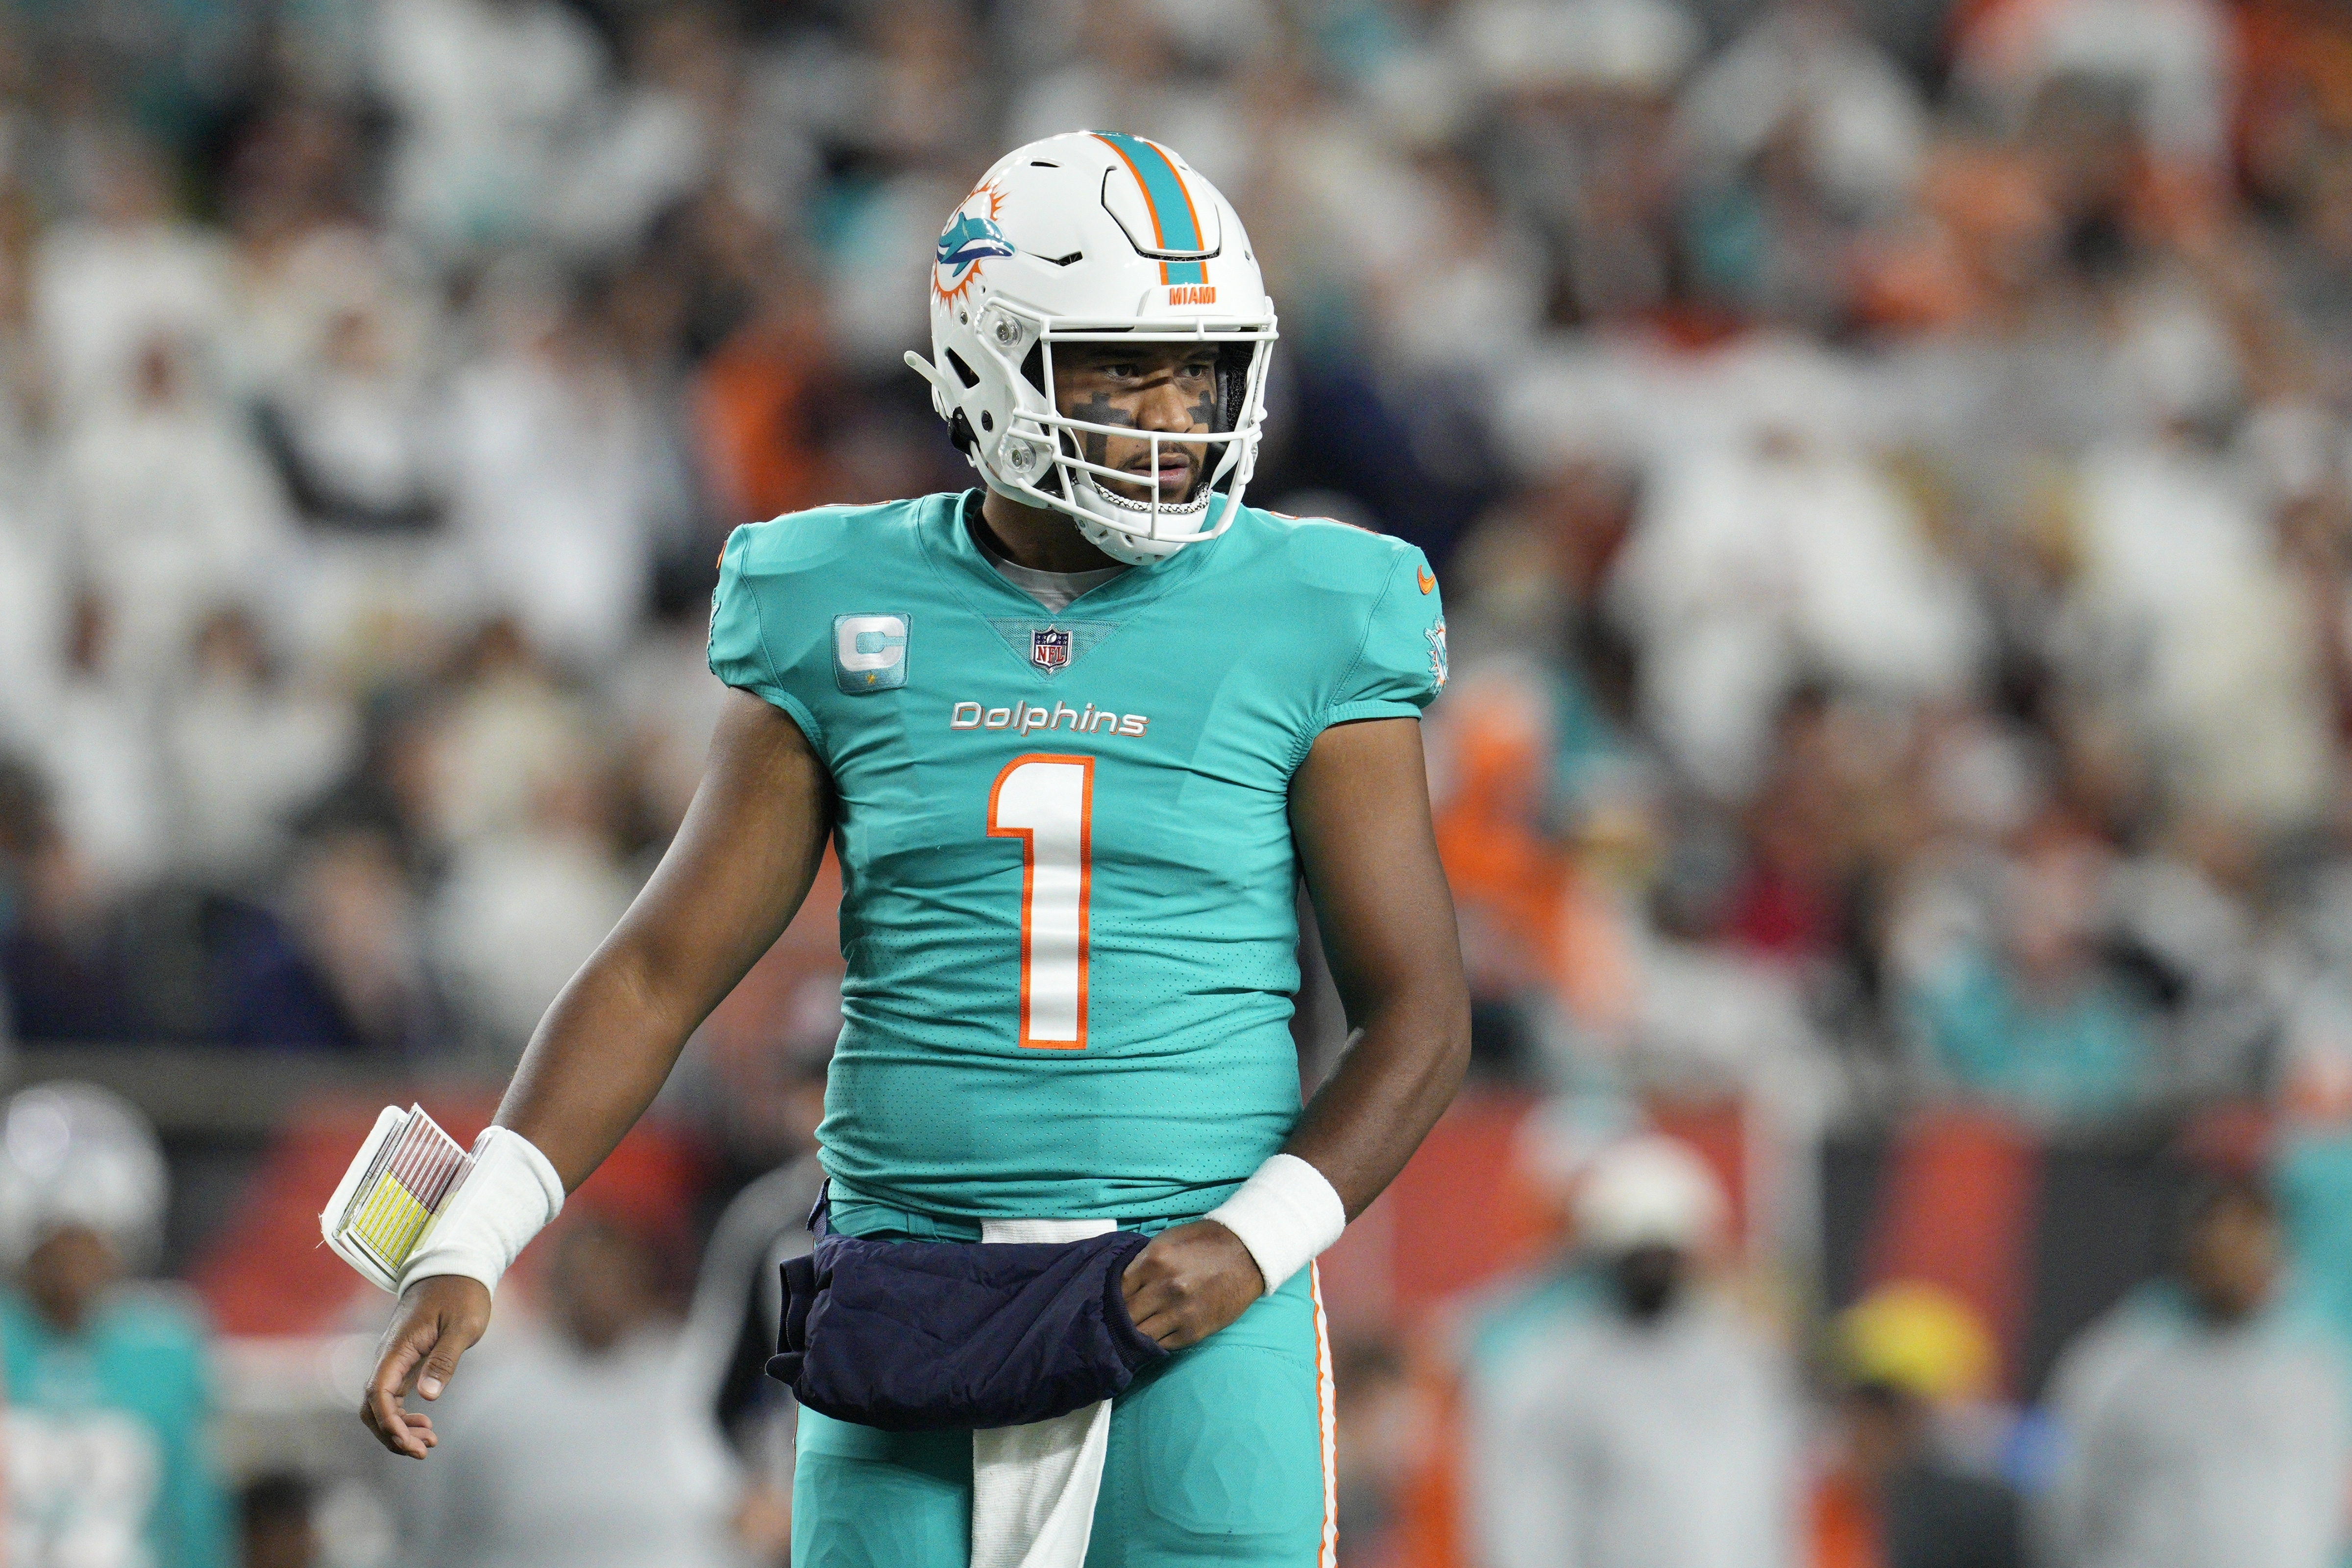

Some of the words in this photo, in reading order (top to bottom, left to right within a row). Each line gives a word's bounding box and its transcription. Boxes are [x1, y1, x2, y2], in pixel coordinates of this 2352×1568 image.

[1170, 287, 1216, 305] MIAMI
[838, 616, 906, 670] C
[1037, 646, 1064, 663] NFL
[951, 700, 1149, 736] Dolphins
[986, 753, 1095, 1050] 1
